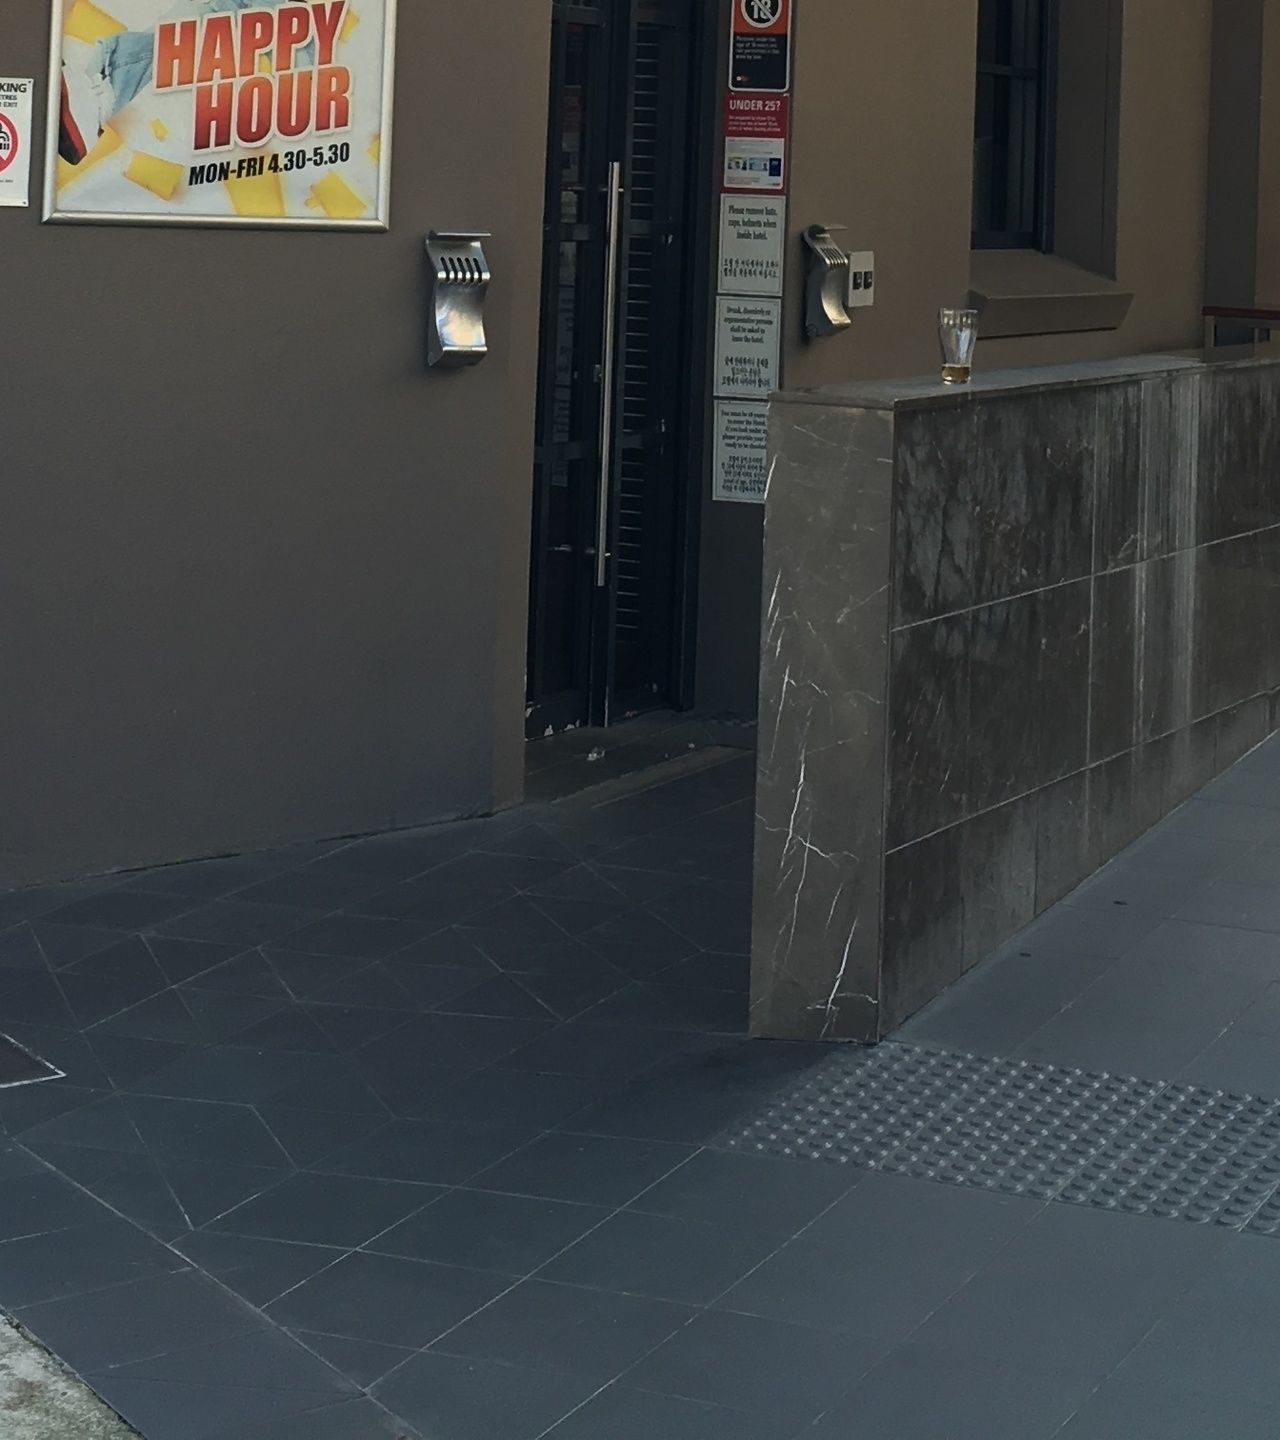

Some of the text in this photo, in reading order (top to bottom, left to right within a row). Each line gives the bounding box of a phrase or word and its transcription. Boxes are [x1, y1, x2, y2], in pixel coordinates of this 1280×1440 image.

[155, 0, 347, 90] HAPPY
[192, 65, 352, 151] HOUR
[729, 99, 782, 112] UNDER 25?
[188, 142, 351, 186] MON-FRI 4.30-5.30
